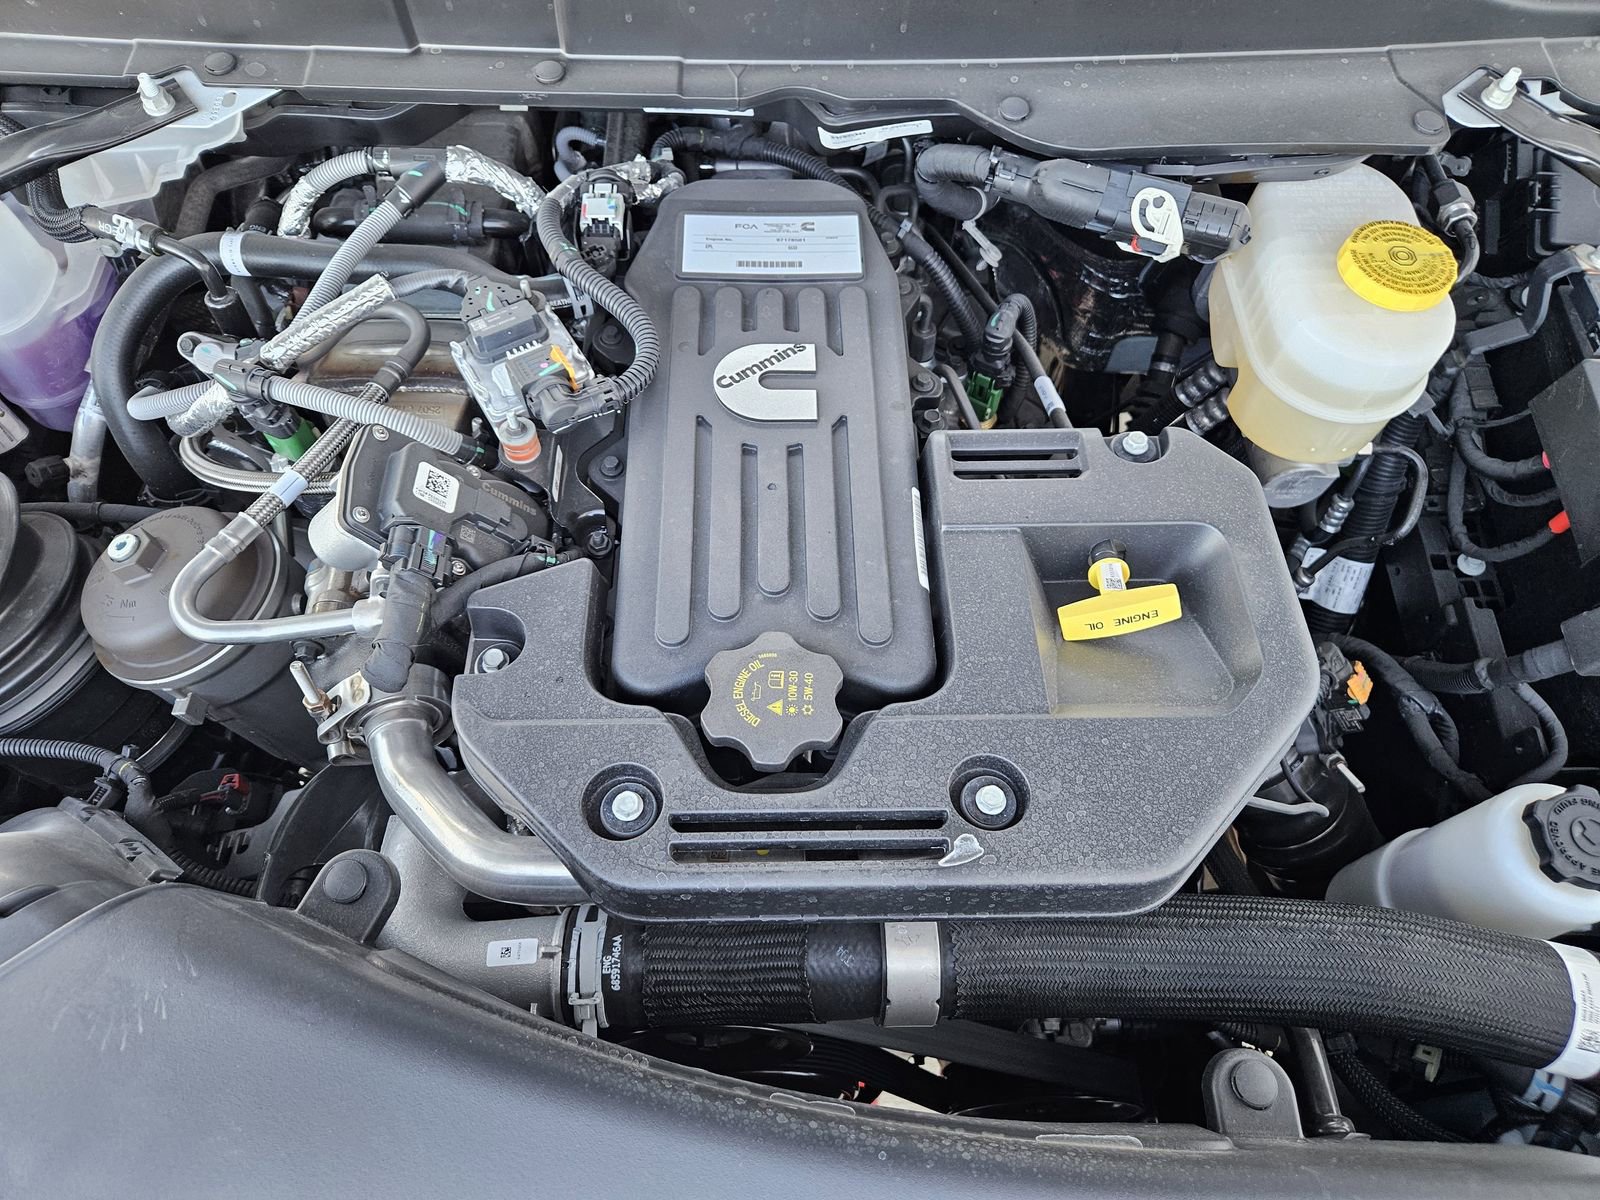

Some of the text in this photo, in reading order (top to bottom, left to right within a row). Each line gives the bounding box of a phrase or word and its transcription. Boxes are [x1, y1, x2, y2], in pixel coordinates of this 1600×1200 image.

[716, 343, 807, 388] Cummins
[481, 481, 537, 516] Cummins
[1085, 610, 1159, 631] ENGINE OIL
[733, 660, 765, 727] DIESEL ENGINE OIL
[788, 671, 798, 700] 10W-30
[804, 672, 814, 700] 5W-40
[602, 955, 612, 975] ENG
[611, 934, 623, 991] 68591746AA
